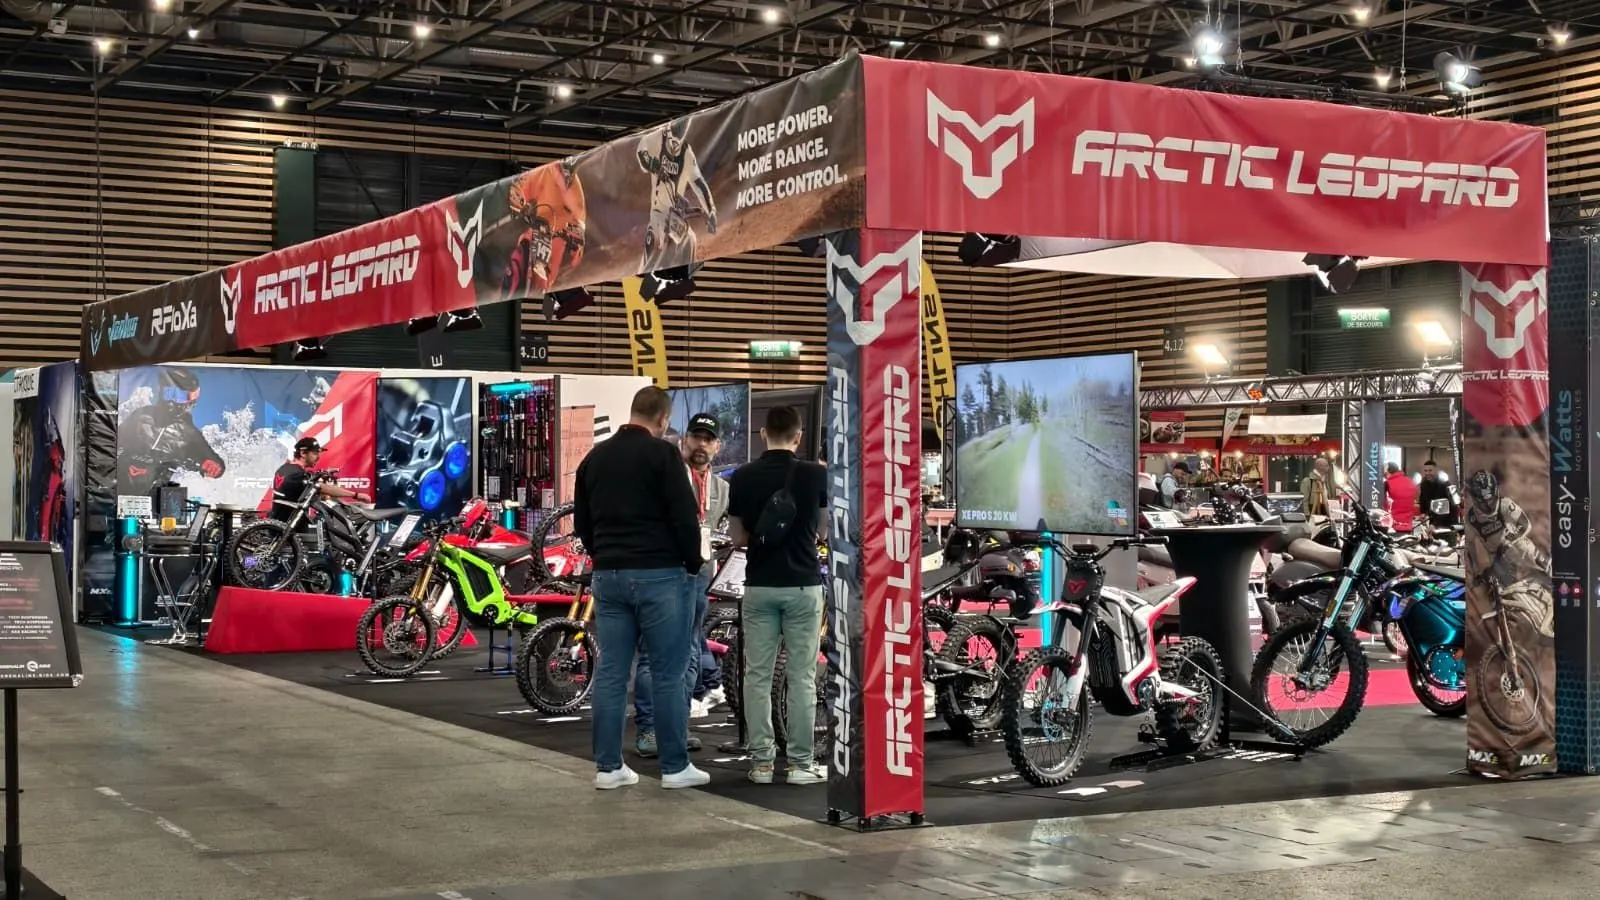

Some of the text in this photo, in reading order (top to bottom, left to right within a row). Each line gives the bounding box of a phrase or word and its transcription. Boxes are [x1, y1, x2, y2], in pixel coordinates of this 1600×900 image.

[738, 105, 833, 152] MORE POWER.
[738, 137, 829, 182] MORE RANGE.
[1071, 129, 1520, 208] ARCTIC LEOPARD
[736, 164, 849, 210] MORE CONTROL.
[253, 234, 421, 315] ARCTIC LEOPARD
[520, 346, 547, 359] 4.10
[1164, 339, 1185, 352] 4.12
[1365, 442, 1380, 508] asy-Watts
[971, 510, 987, 520] PRO
[832, 367, 850, 778] ARCTIC LEOPARD
[883, 363, 913, 777] ARCTIC LEOPARD
